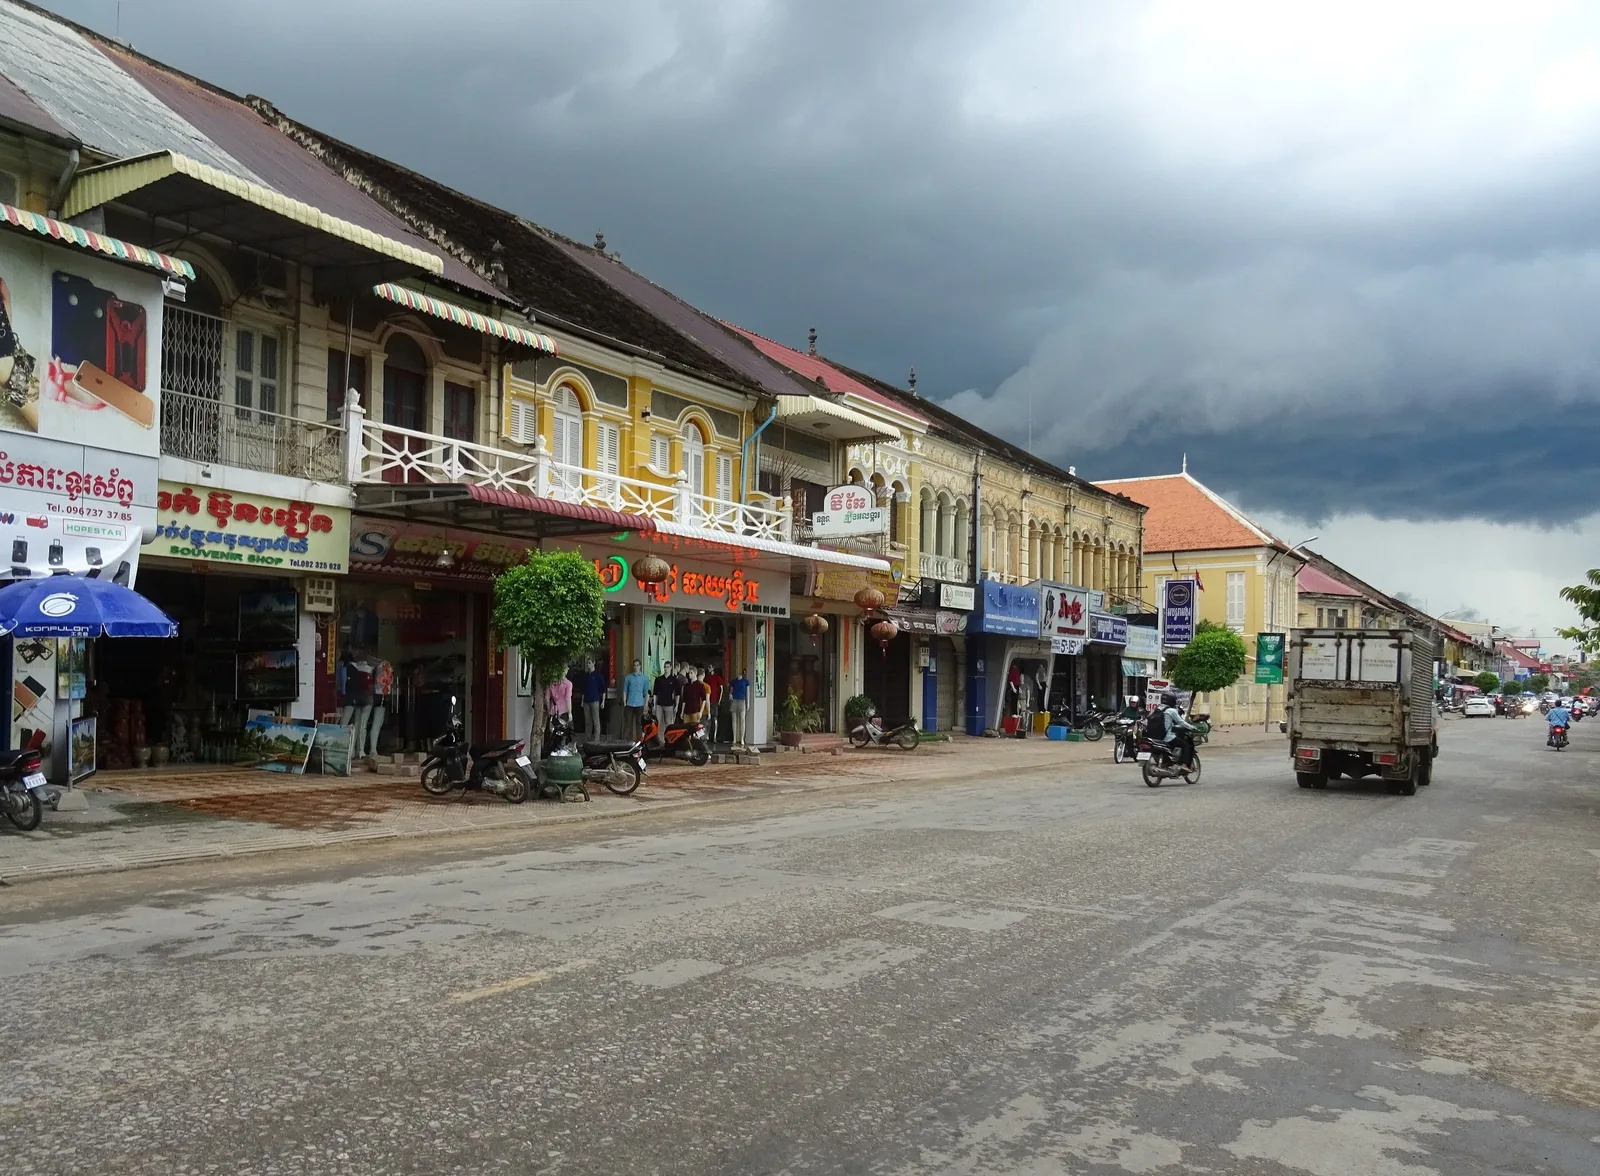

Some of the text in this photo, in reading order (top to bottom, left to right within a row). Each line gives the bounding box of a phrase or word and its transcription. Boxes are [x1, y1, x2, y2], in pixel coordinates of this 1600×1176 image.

[67, 504, 84, 516] 096
[86, 507, 103, 518] 737
[66, 524, 123, 537] HOPESTAR
[170, 546, 284, 565] SOUVENIR SHOP
